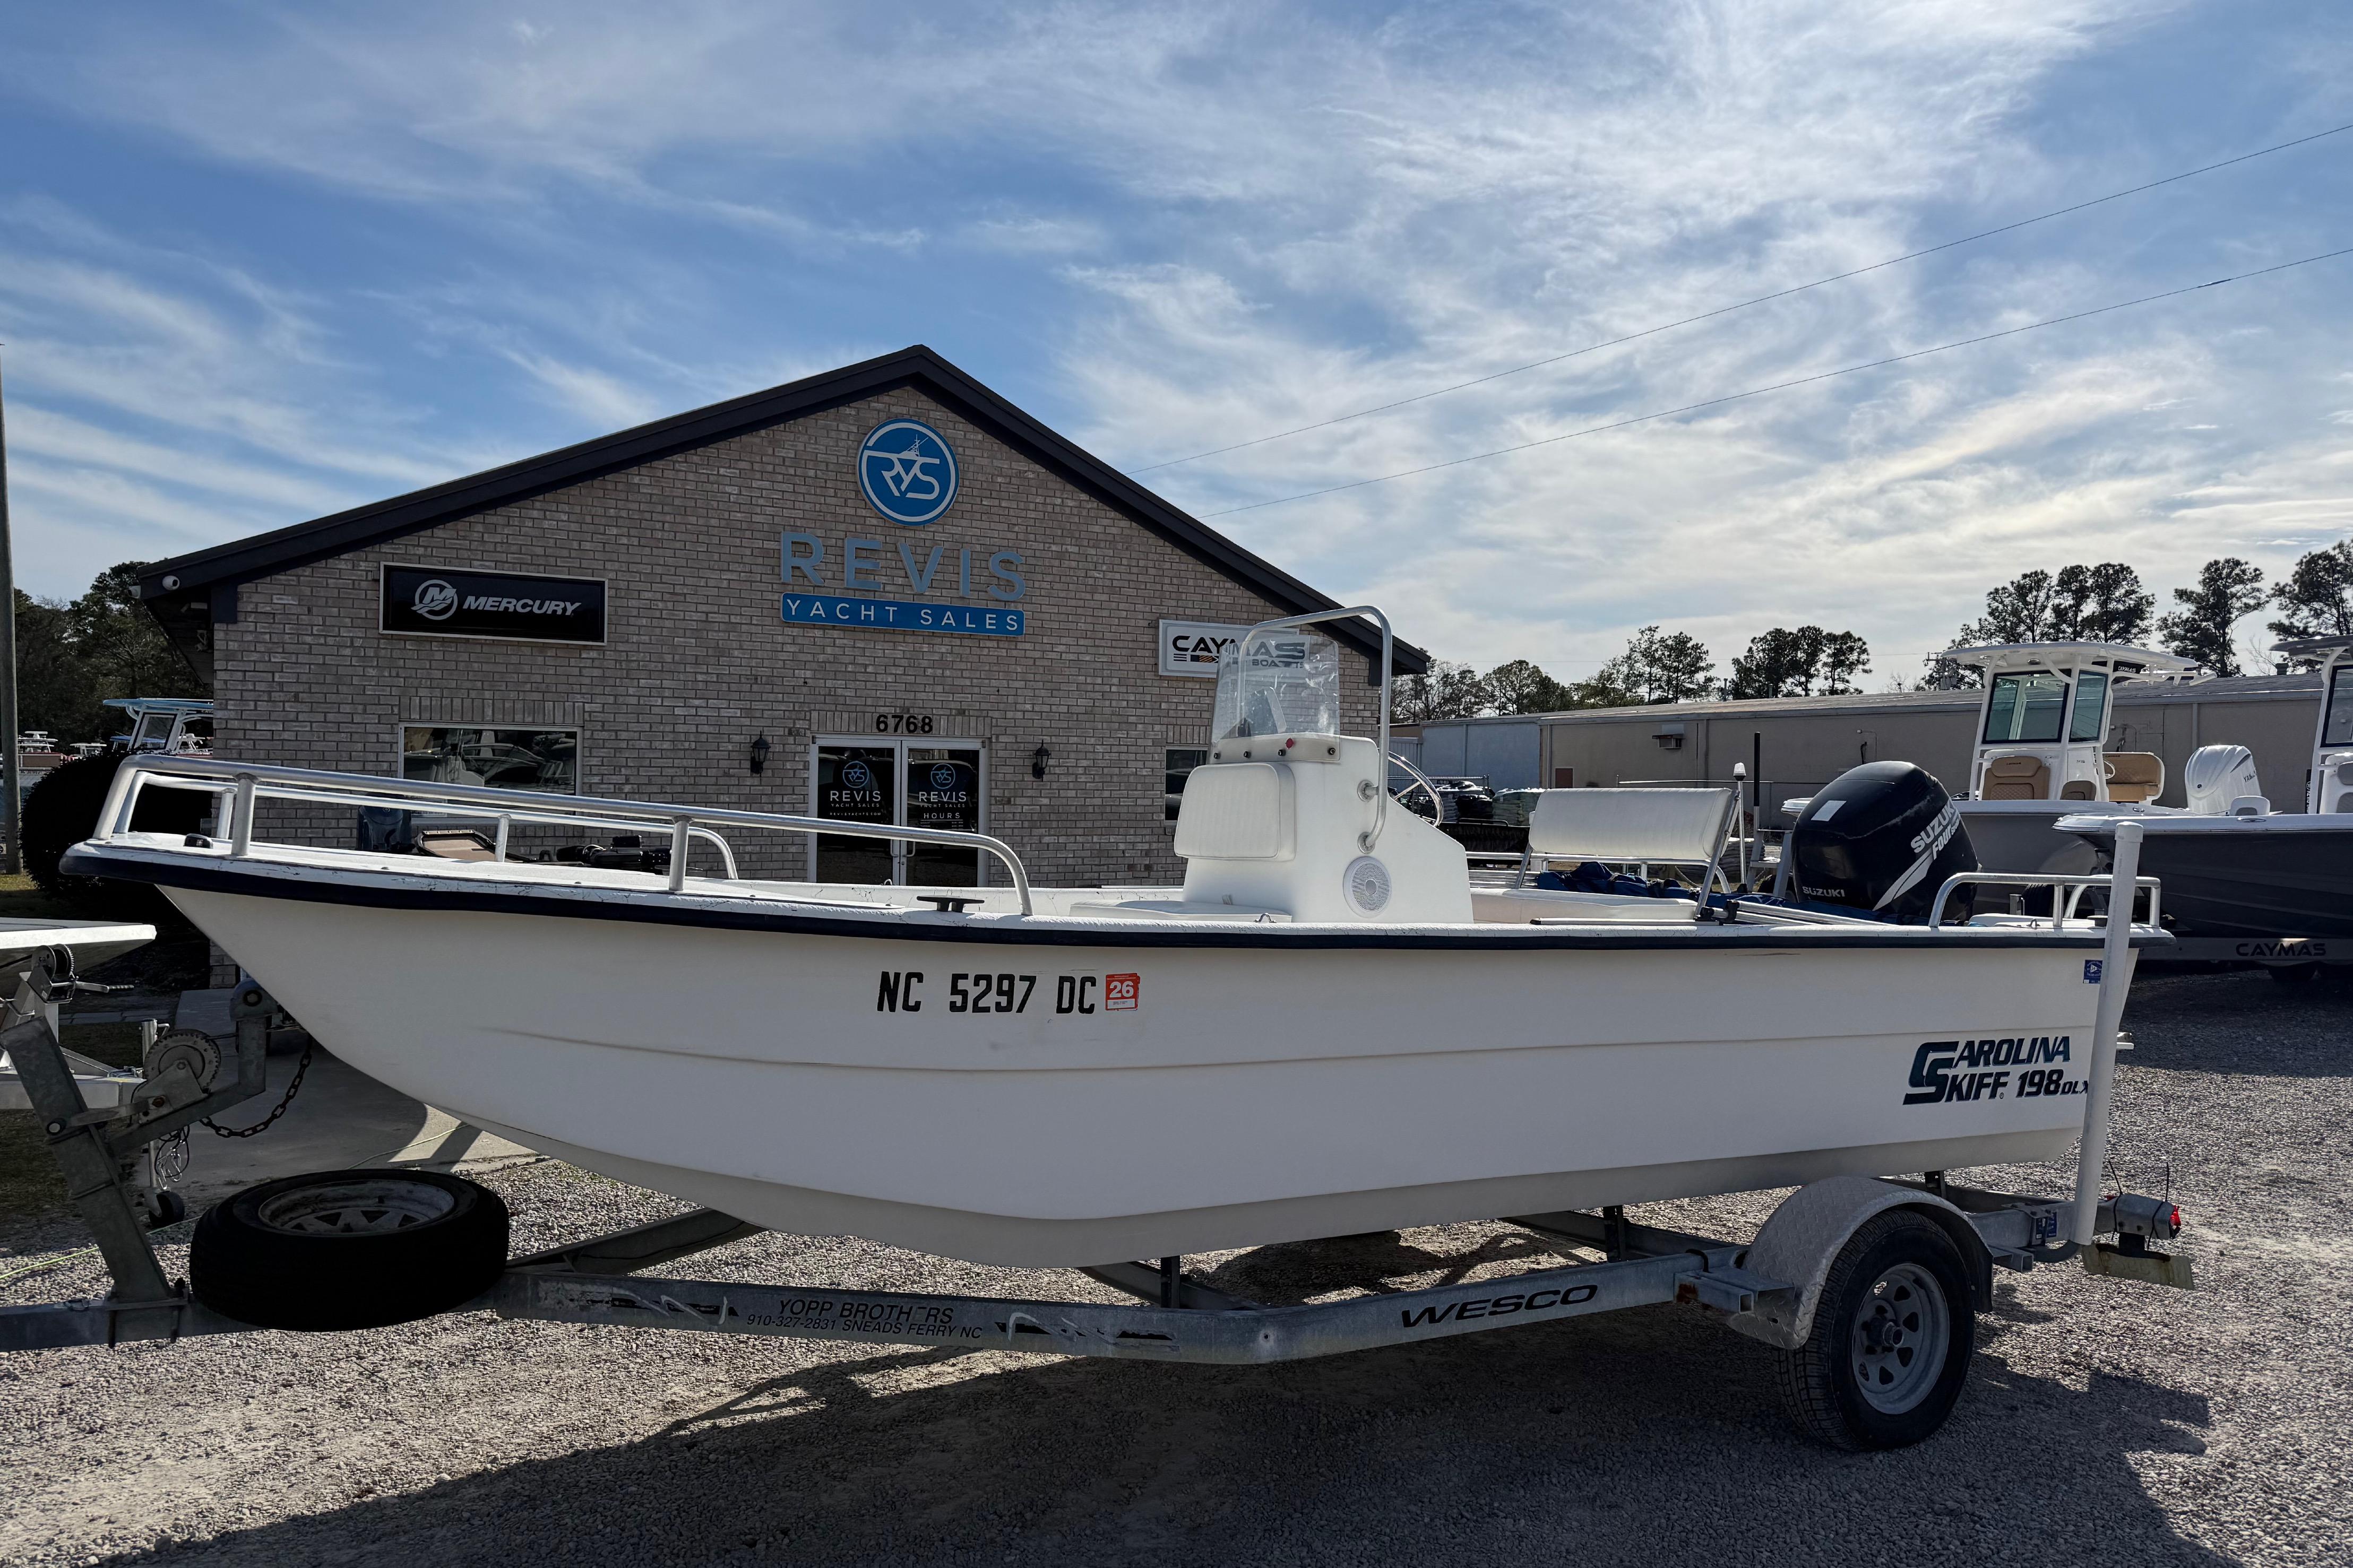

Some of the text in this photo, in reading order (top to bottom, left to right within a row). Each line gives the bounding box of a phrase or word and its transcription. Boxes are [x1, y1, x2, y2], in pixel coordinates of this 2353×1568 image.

[780, 532, 1026, 601] REVIS
[462, 595, 582, 616] MERCURY
[787, 599, 1018, 631] YACHT SALES
[876, 714, 933, 734] 6768
[830, 791, 881, 801] REVIS
[919, 792, 967, 802] REVIS
[1911, 798, 1957, 853] SUZUK
[1802, 886, 1845, 897] SUZUKI
[2236, 943, 2326, 957] CAYMAS
[877, 971, 1097, 1014] NC 5297 DC
[1109, 981, 1134, 998] 26
[1908, 1036, 2071, 1088] CAROLINA
[1902, 1057, 2011, 1105] SKIFF
[780, 1299, 833, 1316] YOPP
[1401, 1284, 1598, 1328] WESCO
[747, 1314, 983, 1339] 910-327-2831 SNEADS FERRY NC
